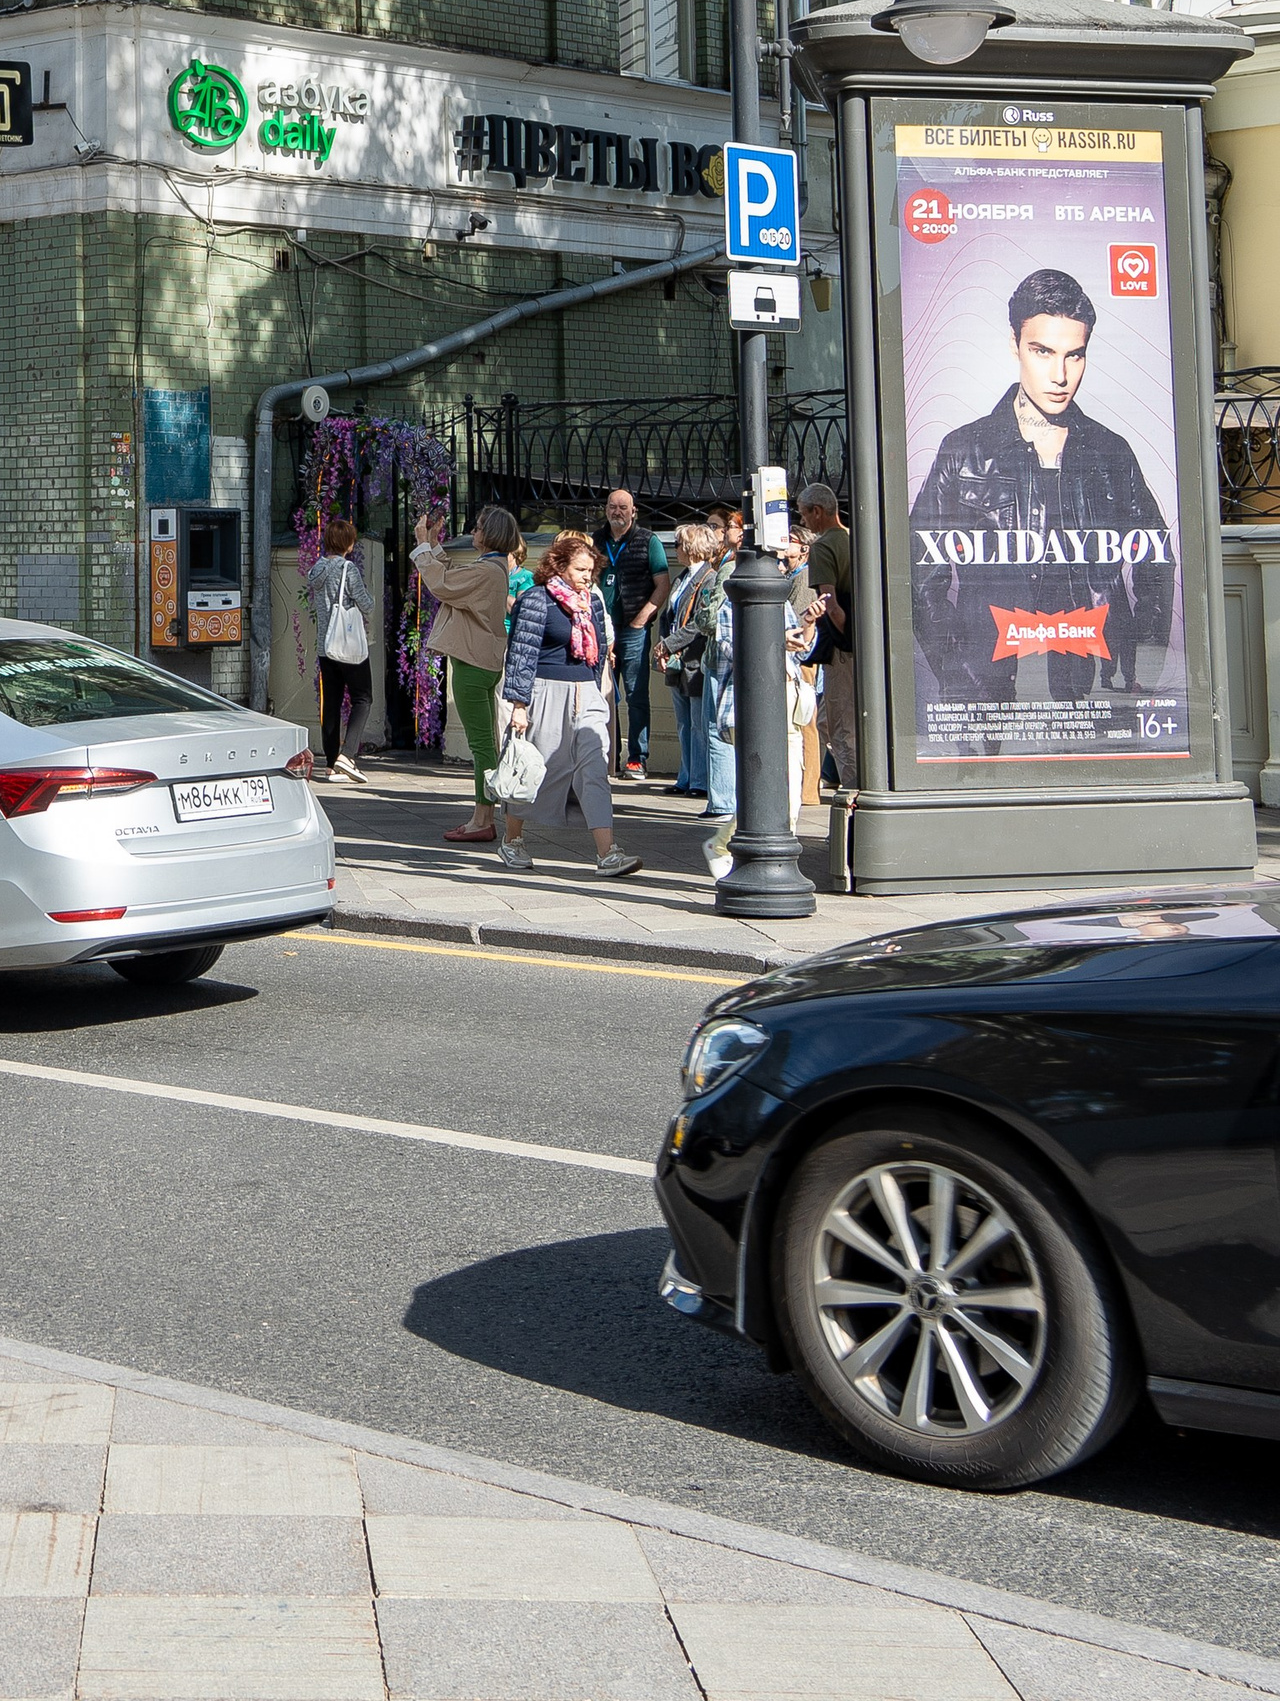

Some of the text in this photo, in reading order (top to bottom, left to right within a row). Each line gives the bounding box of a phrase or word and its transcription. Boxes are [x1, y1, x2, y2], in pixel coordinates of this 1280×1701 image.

[260, 72, 371, 120] азбука
[1022, 110, 1054, 122] Russ
[261, 110, 337, 161] daily
[925, 128, 1027, 147] ВСЕ БИЛЕТЫ
[1057, 131, 1136, 150] KASSIR.RU
[454, 114, 660, 192] #ЦВЕТЫ
[954, 167, 1109, 179] АЛЬФА-БАНК ПРЕДСТАВЛЯЕТ
[738, 158, 777, 247] P
[912, 199, 1034, 220] 21 НОЯБРЯ
[1054, 205, 1155, 223] ВТБ АРЕНА
[769, 232, 777, 243] 15
[779, 231, 790, 245] 20
[922, 224, 958, 234] 20:00
[1120, 281, 1148, 290] LOVE
[1006, 623, 1096, 644] Альфа Банк
[1136, 713, 1178, 738] 16+
[179, 779, 265, 810] М864КК 799
[115, 825, 160, 836] OCTAVIA
